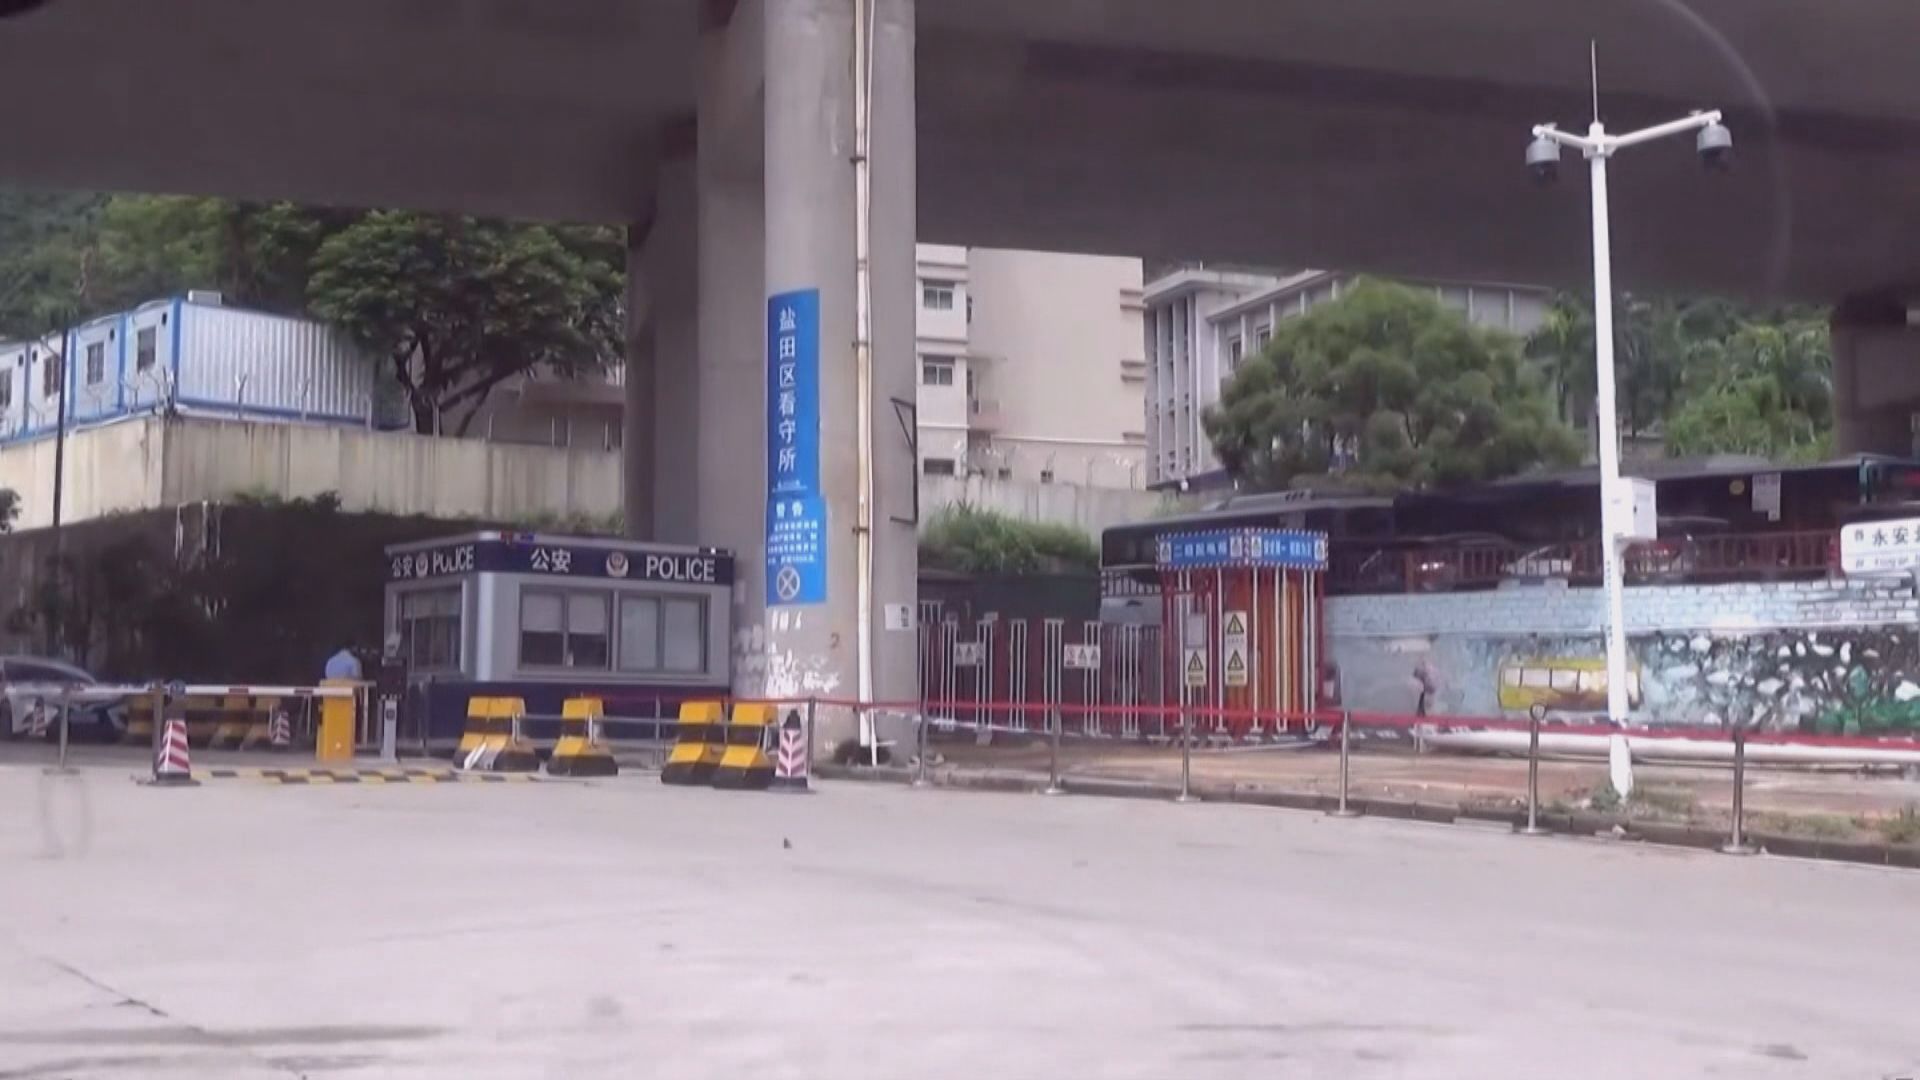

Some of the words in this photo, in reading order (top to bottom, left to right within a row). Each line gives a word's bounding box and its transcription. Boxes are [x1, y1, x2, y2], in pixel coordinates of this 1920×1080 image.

[778, 305, 797, 473] 盐田区看守所
[392, 553, 413, 578] 公安
[433, 545, 475, 575] POLICE
[530, 548, 572, 574] 公安
[646, 555, 716, 582] POLICE
